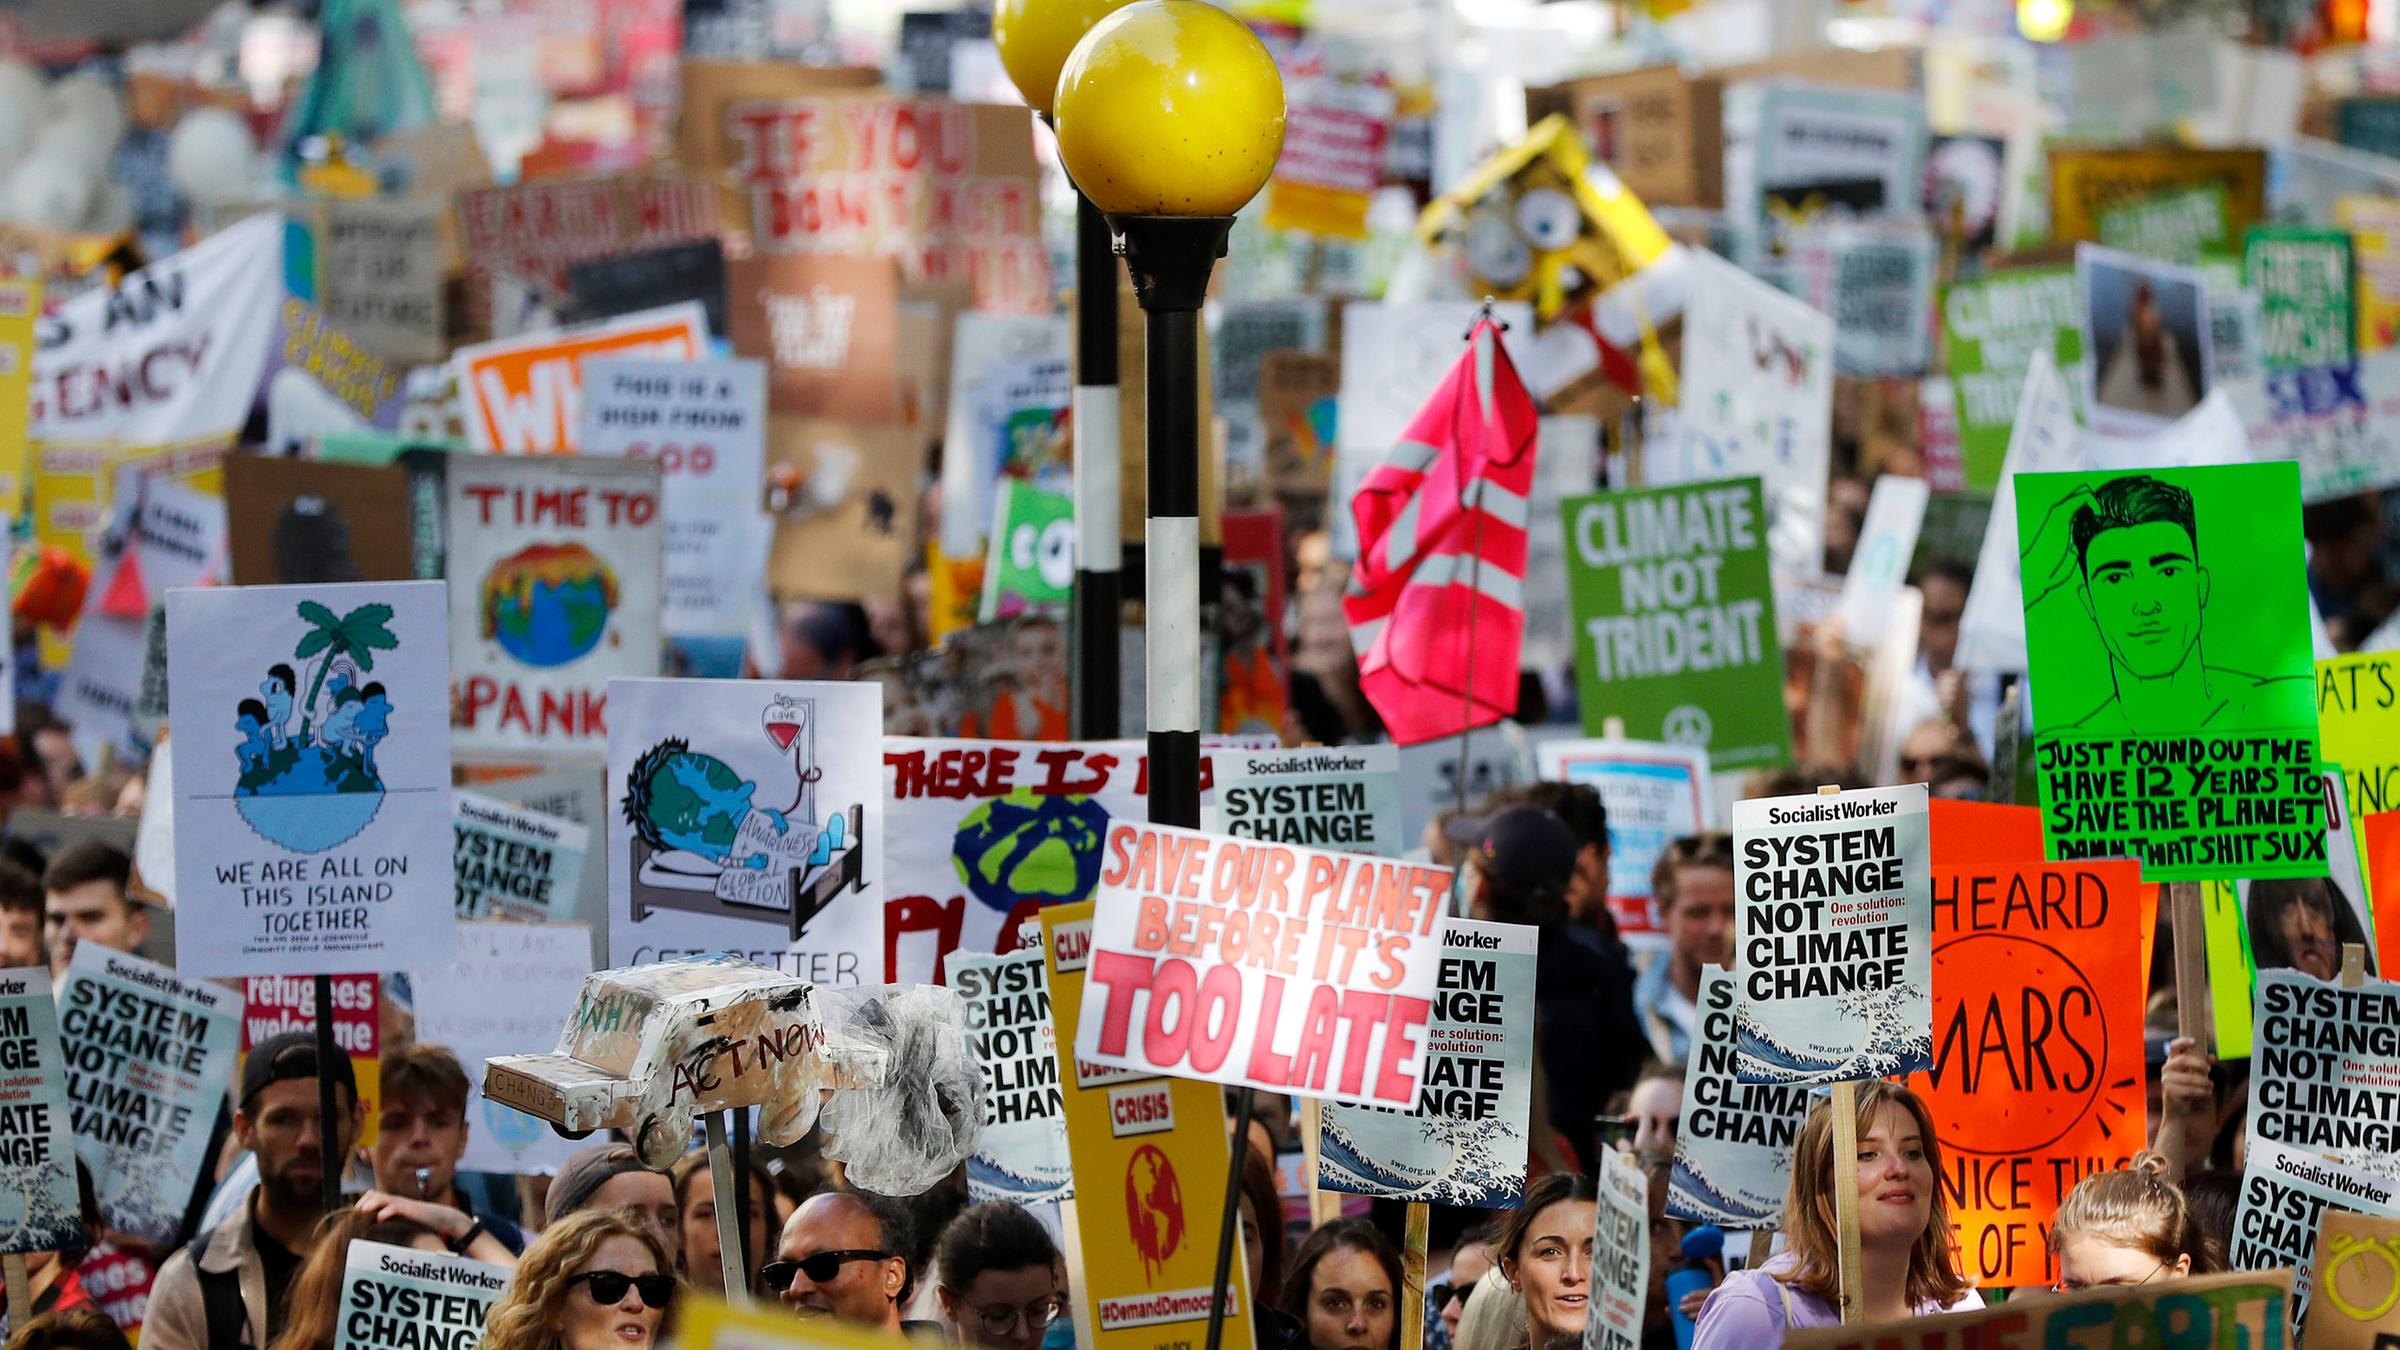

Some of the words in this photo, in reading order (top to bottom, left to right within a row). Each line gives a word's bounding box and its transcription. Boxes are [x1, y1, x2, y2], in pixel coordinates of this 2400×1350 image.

[848, 107, 964, 174] YOU
[103, 265, 186, 334] AN
[464, 484, 589, 528] TIME
[602, 489, 657, 528] TO
[1576, 485, 1757, 569] CLIMATE
[1619, 553, 1723, 613] NOT
[1586, 600, 1762, 682] TRIDENT
[2315, 663, 2395, 715] AT'S
[772, 711, 796, 721] LOVE
[884, 748, 1020, 799] THERE
[1032, 749, 1119, 796] IS
[1248, 756, 1313, 776] Socialist
[1314, 755, 1367, 772] Worker
[2037, 739, 2113, 771] JUST
[2121, 738, 2205, 765] FOUND
[2208, 739, 2268, 763] OUT
[2269, 739, 2312, 764] WE
[1225, 782, 1365, 816] SYSTEM
[2051, 770, 2127, 800] HAVE
[2136, 766, 2175, 797] 12
[2187, 765, 2279, 797] YEARS
[2285, 768, 2323, 795] TO
[1228, 813, 1375, 845] CHANGE
[1769, 803, 1841, 825] Socialist
[1842, 799, 1898, 820] Worker
[2051, 801, 2130, 834] SAVE
[2131, 800, 2190, 830] THE
[2198, 797, 2324, 829] PLANET
[1743, 826, 1896, 870] SYSTEM
[2130, 836, 2198, 866] THAT
[2198, 833, 2260, 864] SHIT
[2261, 829, 2327, 862] SUX
[216, 861, 254, 885] WE
[262, 859, 308, 883] ARE
[321, 856, 364, 880] ALL
[374, 855, 408, 877] ON
[1102, 826, 1210, 898] SAVE
[1211, 842, 1296, 912] OUR
[1303, 855, 1454, 936] PLANET
[1745, 858, 1905, 901] CHANGE
[241, 885, 293, 908] THIS
[307, 882, 393, 907] ISLAND
[1747, 900, 1825, 936] NOT
[1830, 902, 1854, 914] One
[1856, 896, 1907, 911] solution:
[1931, 873, 2109, 932] HEARD
[1831, 911, 1890, 928] revolution
[1134, 896, 1308, 976] BEFORE
[1312, 921, 1411, 990] IT'S
[1747, 924, 1909, 969] CLIMATE
[247, 975, 374, 1018] refuges
[1706, 979, 1737, 1010] S
[1748, 957, 1906, 1001] CHANGE
[70, 978, 210, 1044] SYSTEM
[1091, 948, 1243, 1074] TOO
[1246, 974, 1433, 1104] LATE
[62, 1008, 209, 1077] CHANGE
[965, 1025, 1037, 1061] NOT
[1449, 1029, 1504, 1043] solution:
[1808, 1042, 1855, 1055] swp.org.uk
[1930, 985, 2096, 1095] MARS
[2263, 1016, 2400, 1059] CHANG
[667, 1039, 747, 1108] ACT
[756, 1022, 827, 1071] NOW
[2261, 1048, 2338, 1083] NOT
[2342, 1059, 2366, 1072] One
[64, 1071, 193, 1137] LIMATE
[1113, 1091, 1170, 1126] CRISIS
[2259, 1079, 2400, 1122] CLIMAT
[2256, 1112, 2400, 1153] CHANG
[1390, 1158, 1438, 1177] swp.org.uk
[2275, 1153, 2335, 1188] Socialist
[2334, 1173, 2393, 1205] Worker
[1978, 1222, 2027, 1280] OF
[380, 1255, 447, 1282] Socialist
[449, 1267, 506, 1291] Worker
